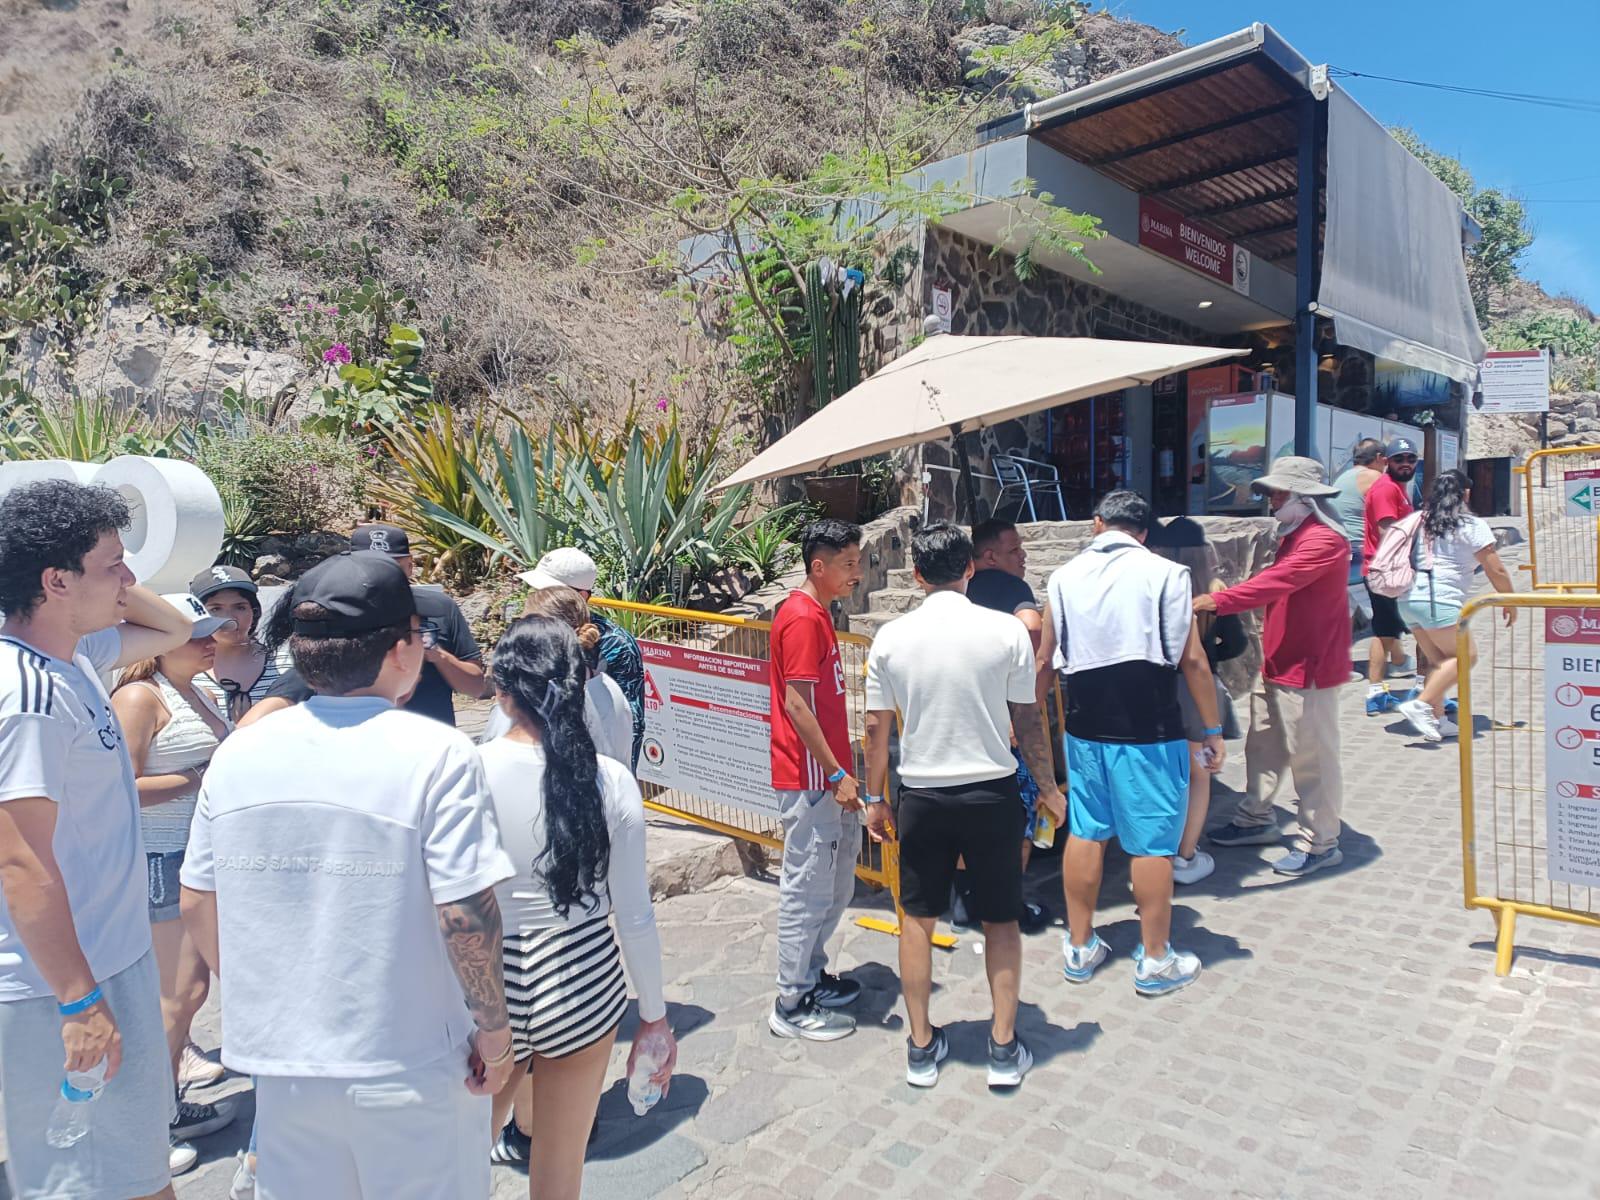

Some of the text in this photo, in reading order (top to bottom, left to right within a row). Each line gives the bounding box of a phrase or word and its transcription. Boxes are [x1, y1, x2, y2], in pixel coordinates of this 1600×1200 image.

[1150, 219, 1173, 238] MARINA
[1180, 223, 1226, 258] BIENVENIDOS
[1185, 245, 1221, 273] WELCOME
[1580, 618, 1600, 630] M
[643, 646, 671, 658] MARINA
[698, 662, 746, 677] ANTES DE SUBIR
[723, 658, 761, 672] IMPORTANTE
[643, 698, 659, 712] LTO
[708, 703, 763, 721] Recomendaciones
[1568, 804, 1597, 812] Ingresar
[1568, 812, 1597, 821] Ingresar
[1568, 820, 1597, 829] Ingresar
[215, 855, 267, 872] PARIS
